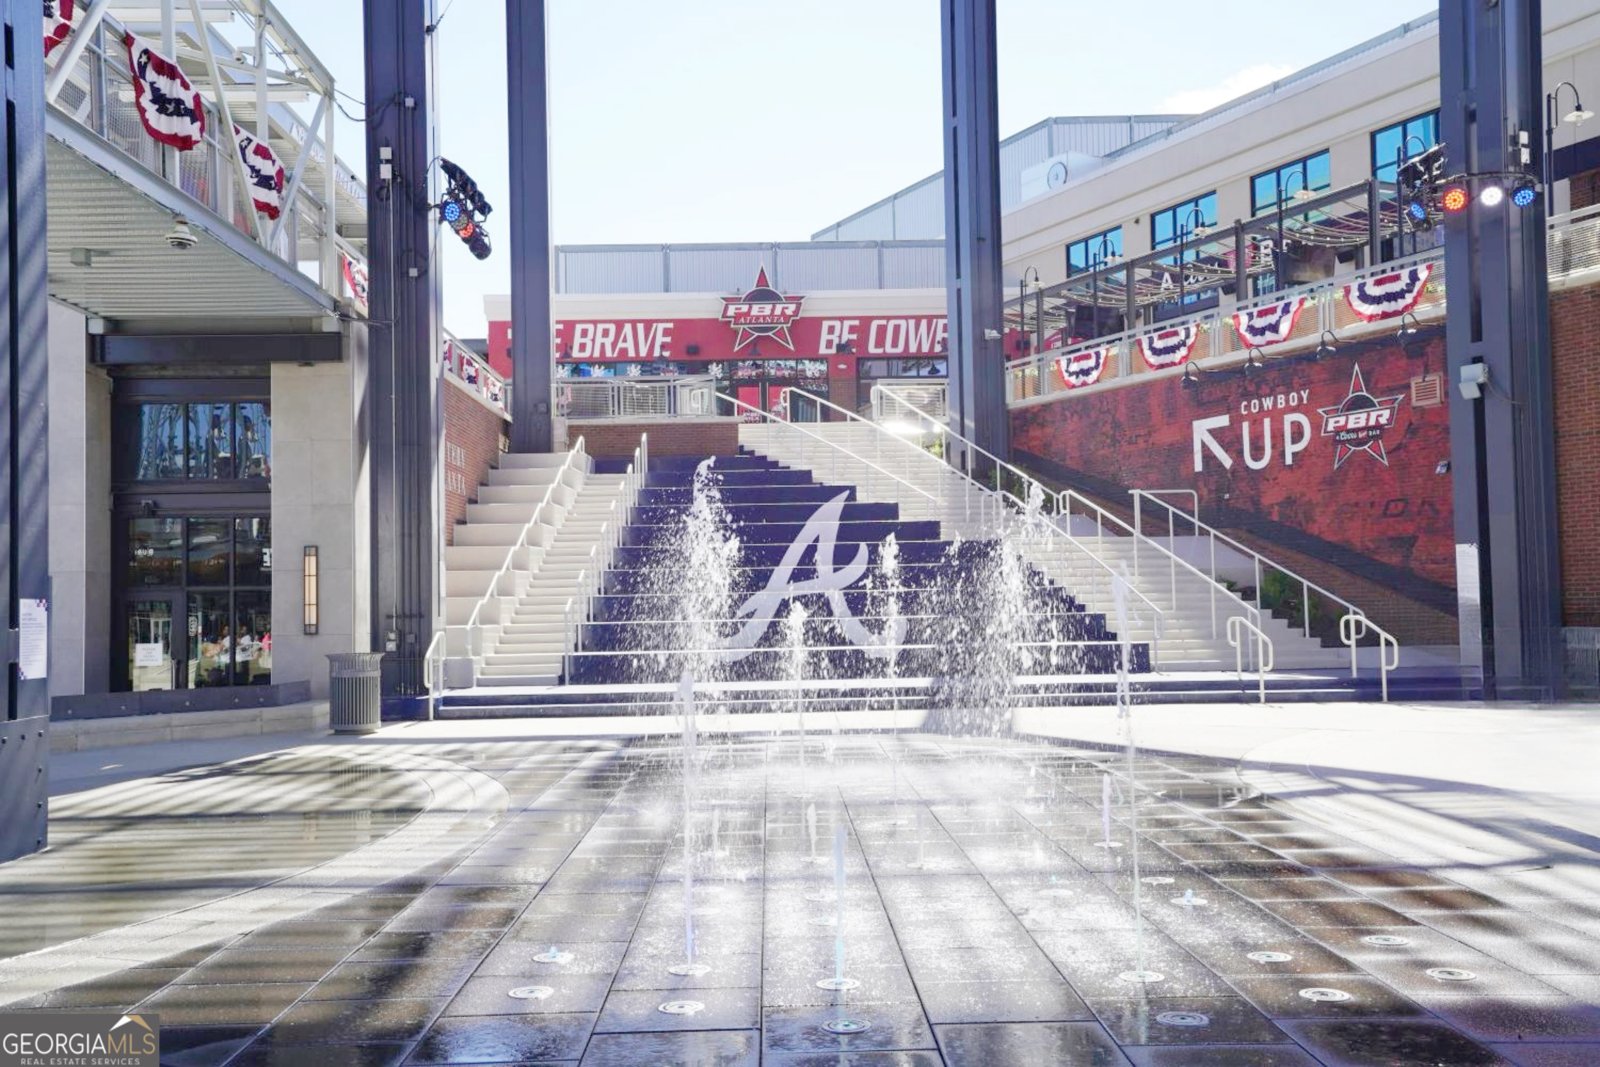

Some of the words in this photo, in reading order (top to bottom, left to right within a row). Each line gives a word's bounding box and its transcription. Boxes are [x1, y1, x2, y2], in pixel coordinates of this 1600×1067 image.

[726, 303, 797, 317] PBR
[738, 316, 785, 324] ATLANTA
[572, 322, 674, 358] BRAVE
[818, 319, 860, 354] BE
[1241, 389, 1310, 415] COWBOY
[1326, 409, 1391, 431] PBR
[1242, 412, 1311, 470] UP
